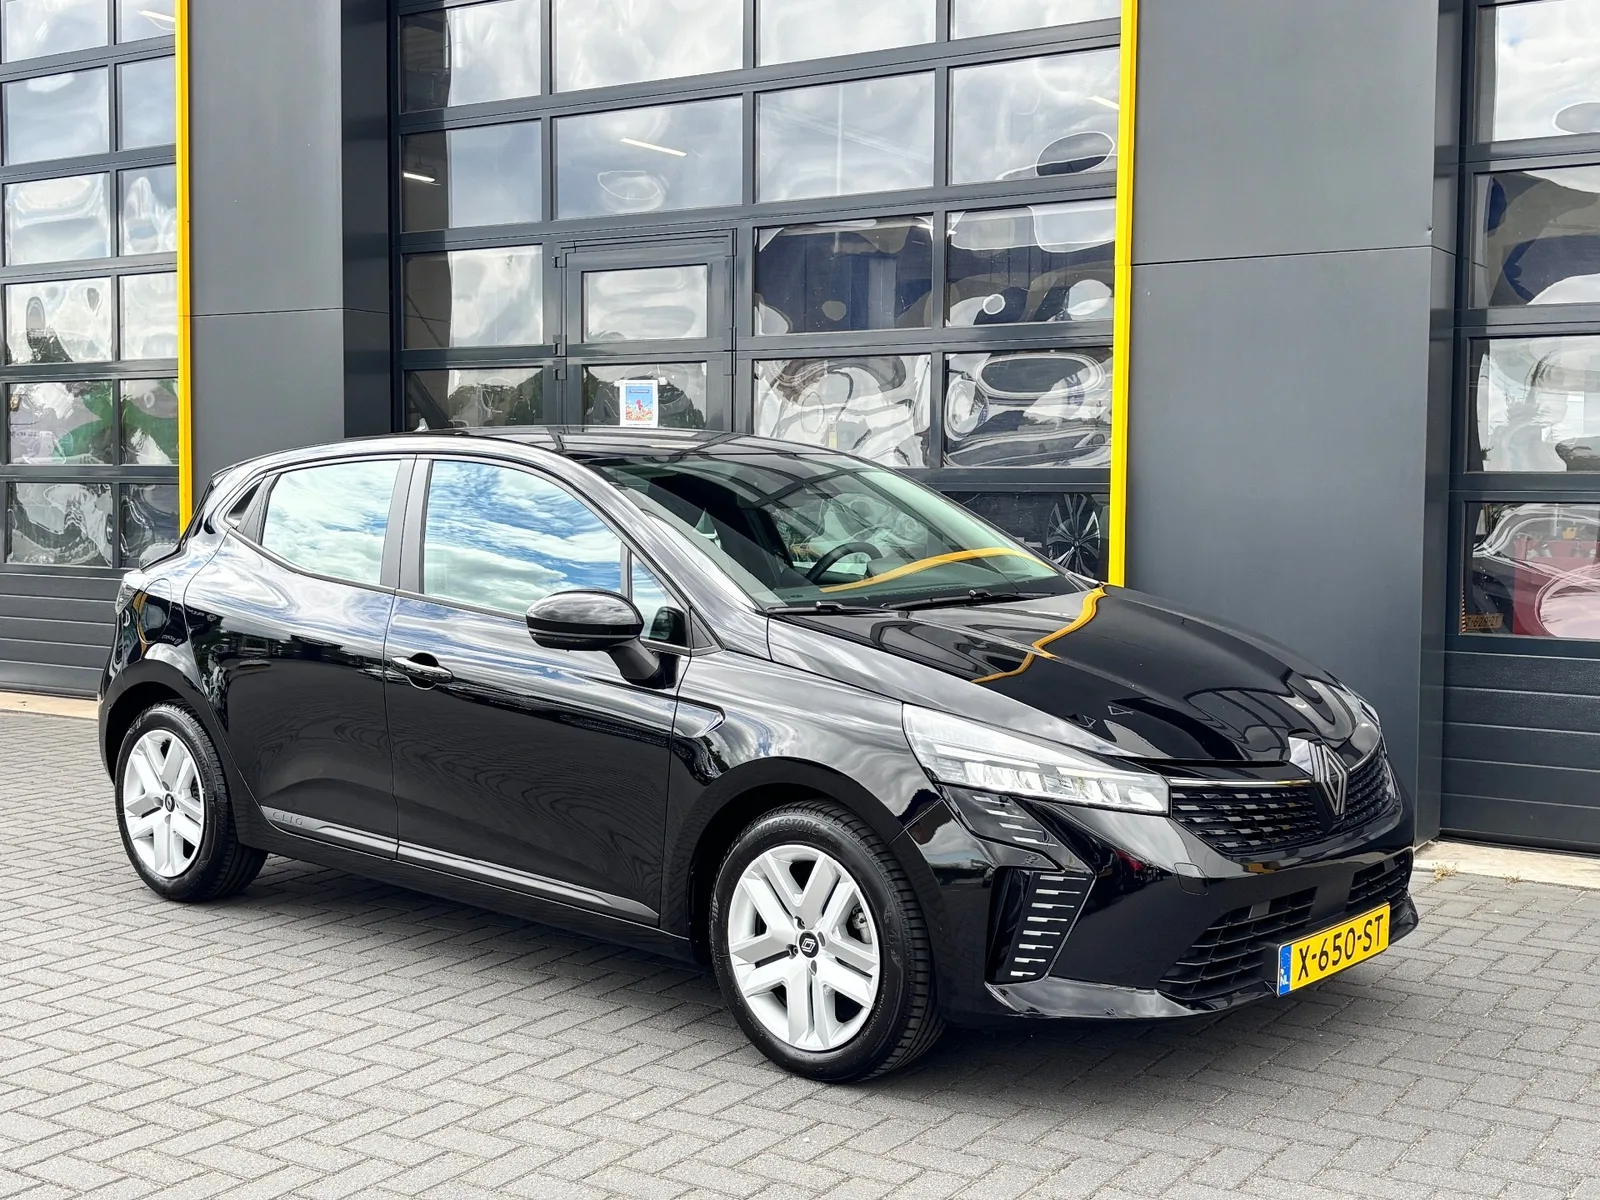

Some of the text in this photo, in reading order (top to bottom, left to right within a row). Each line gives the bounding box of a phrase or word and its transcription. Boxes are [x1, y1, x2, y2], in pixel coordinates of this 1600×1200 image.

[272, 811, 303, 826] CLIO
[1297, 913, 1384, 982] X-650-ST
[1280, 974, 1289, 987] NL
